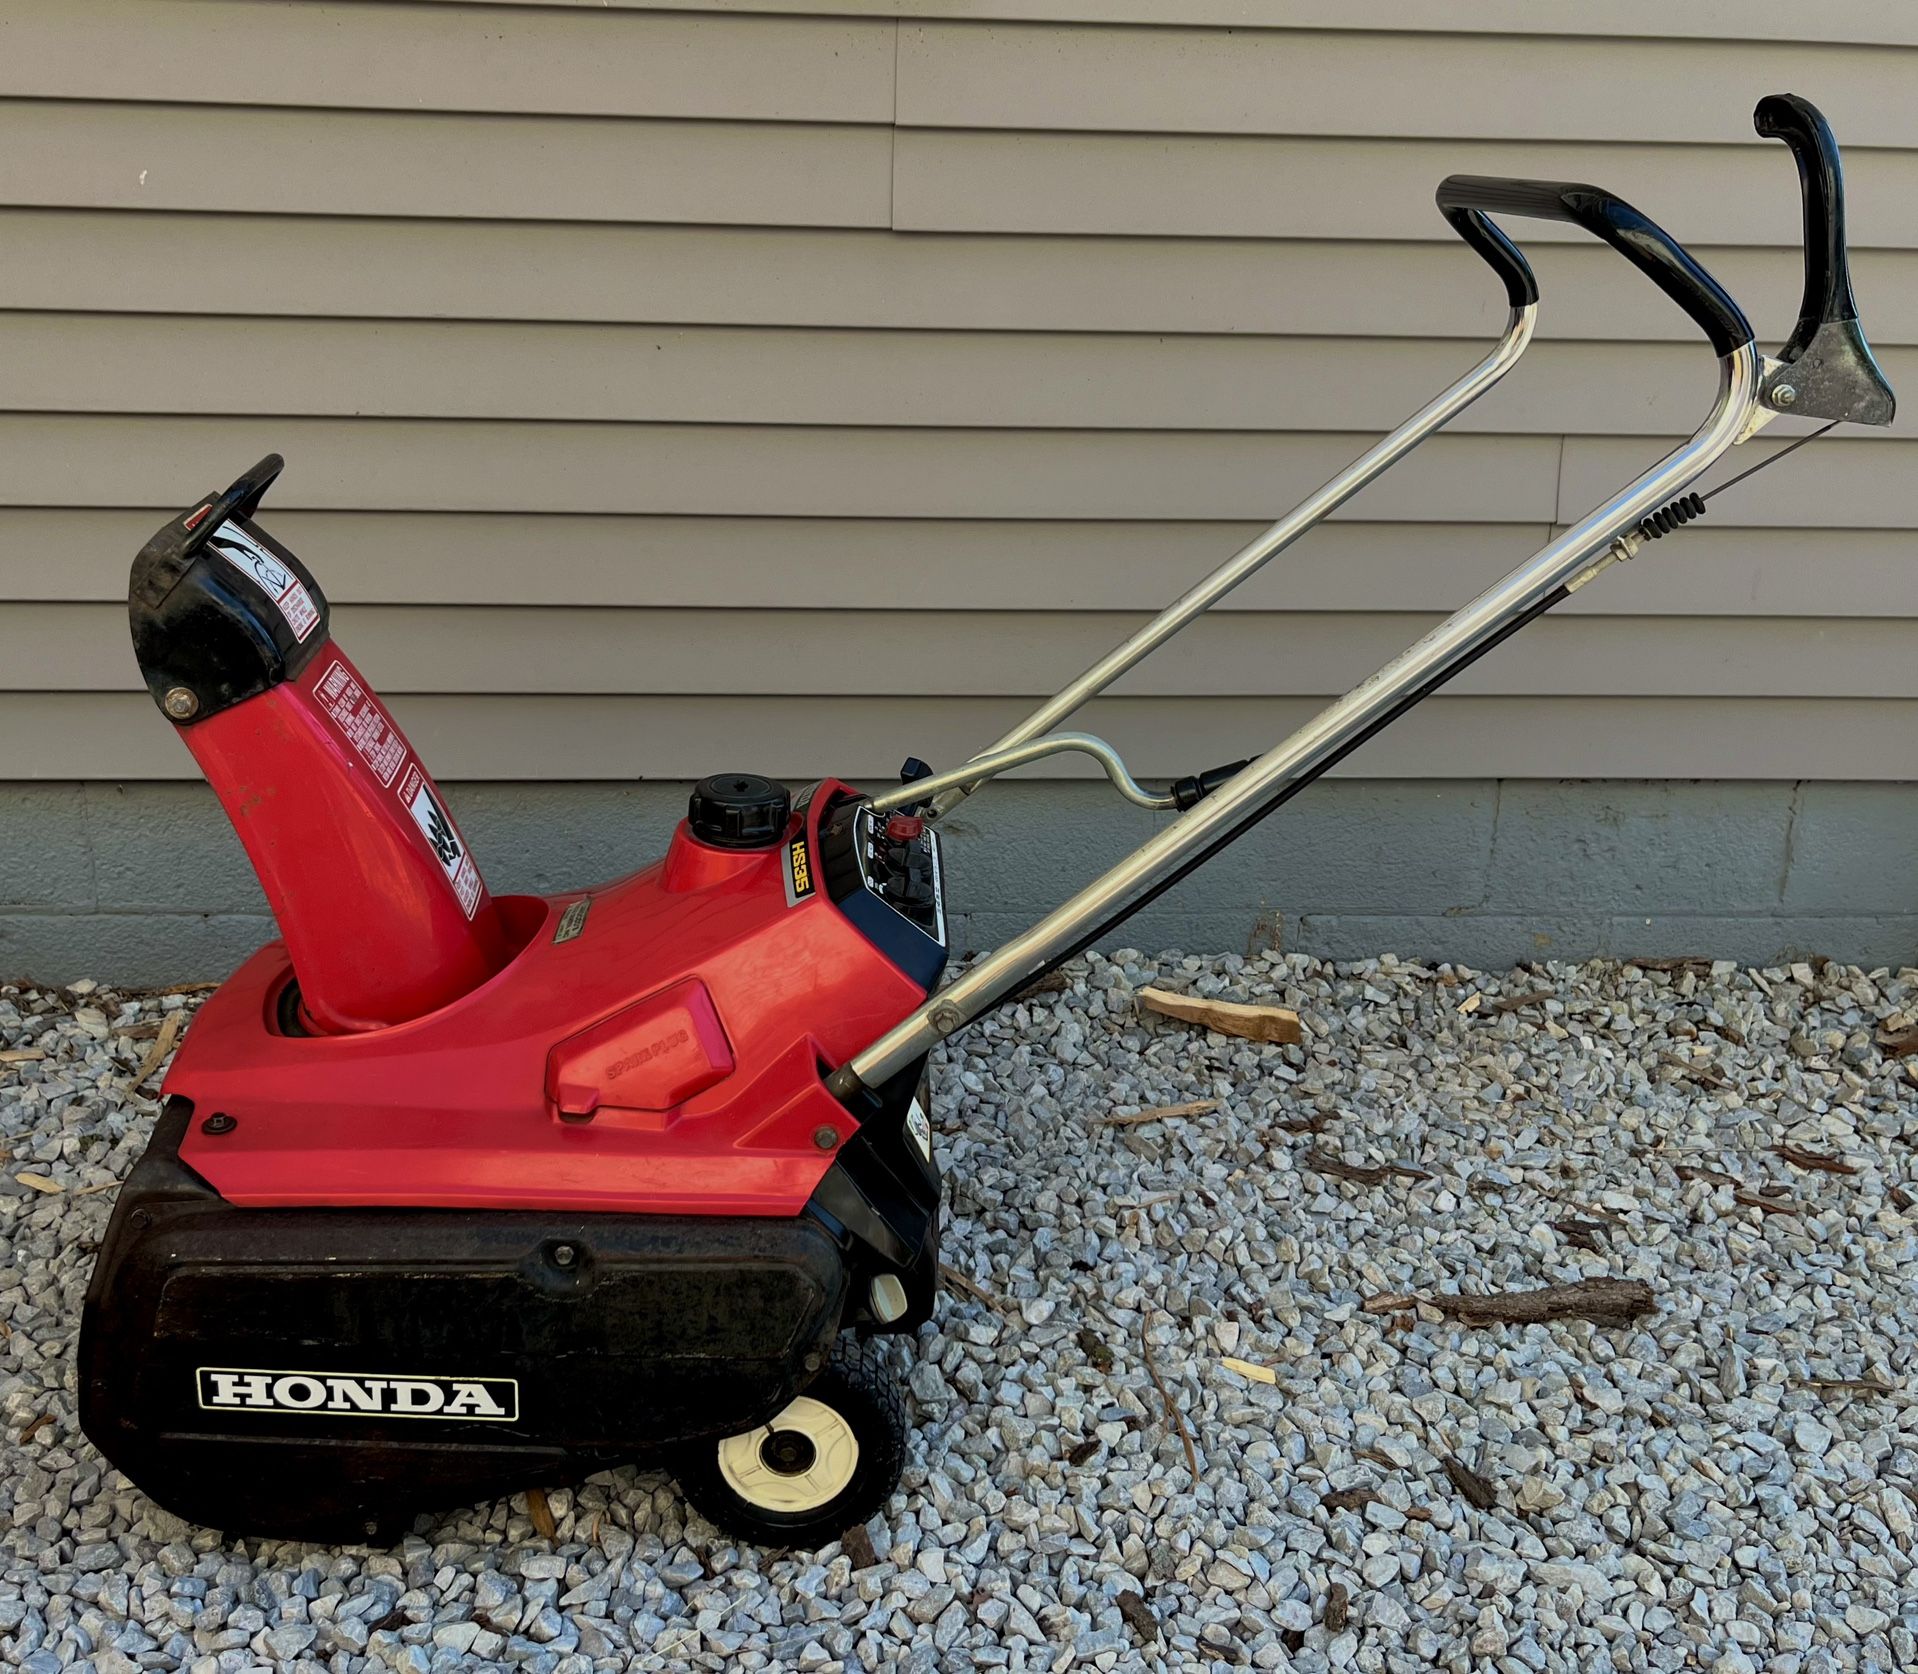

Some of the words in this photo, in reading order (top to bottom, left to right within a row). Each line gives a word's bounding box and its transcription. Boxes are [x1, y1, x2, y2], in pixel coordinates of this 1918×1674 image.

[323, 666, 349, 700] WARNING
[792, 841, 809, 892] HS35
[606, 1047, 653, 1080] SPARK
[651, 1029, 689, 1057] PLUG
[210, 1373, 506, 1416] HONDA
